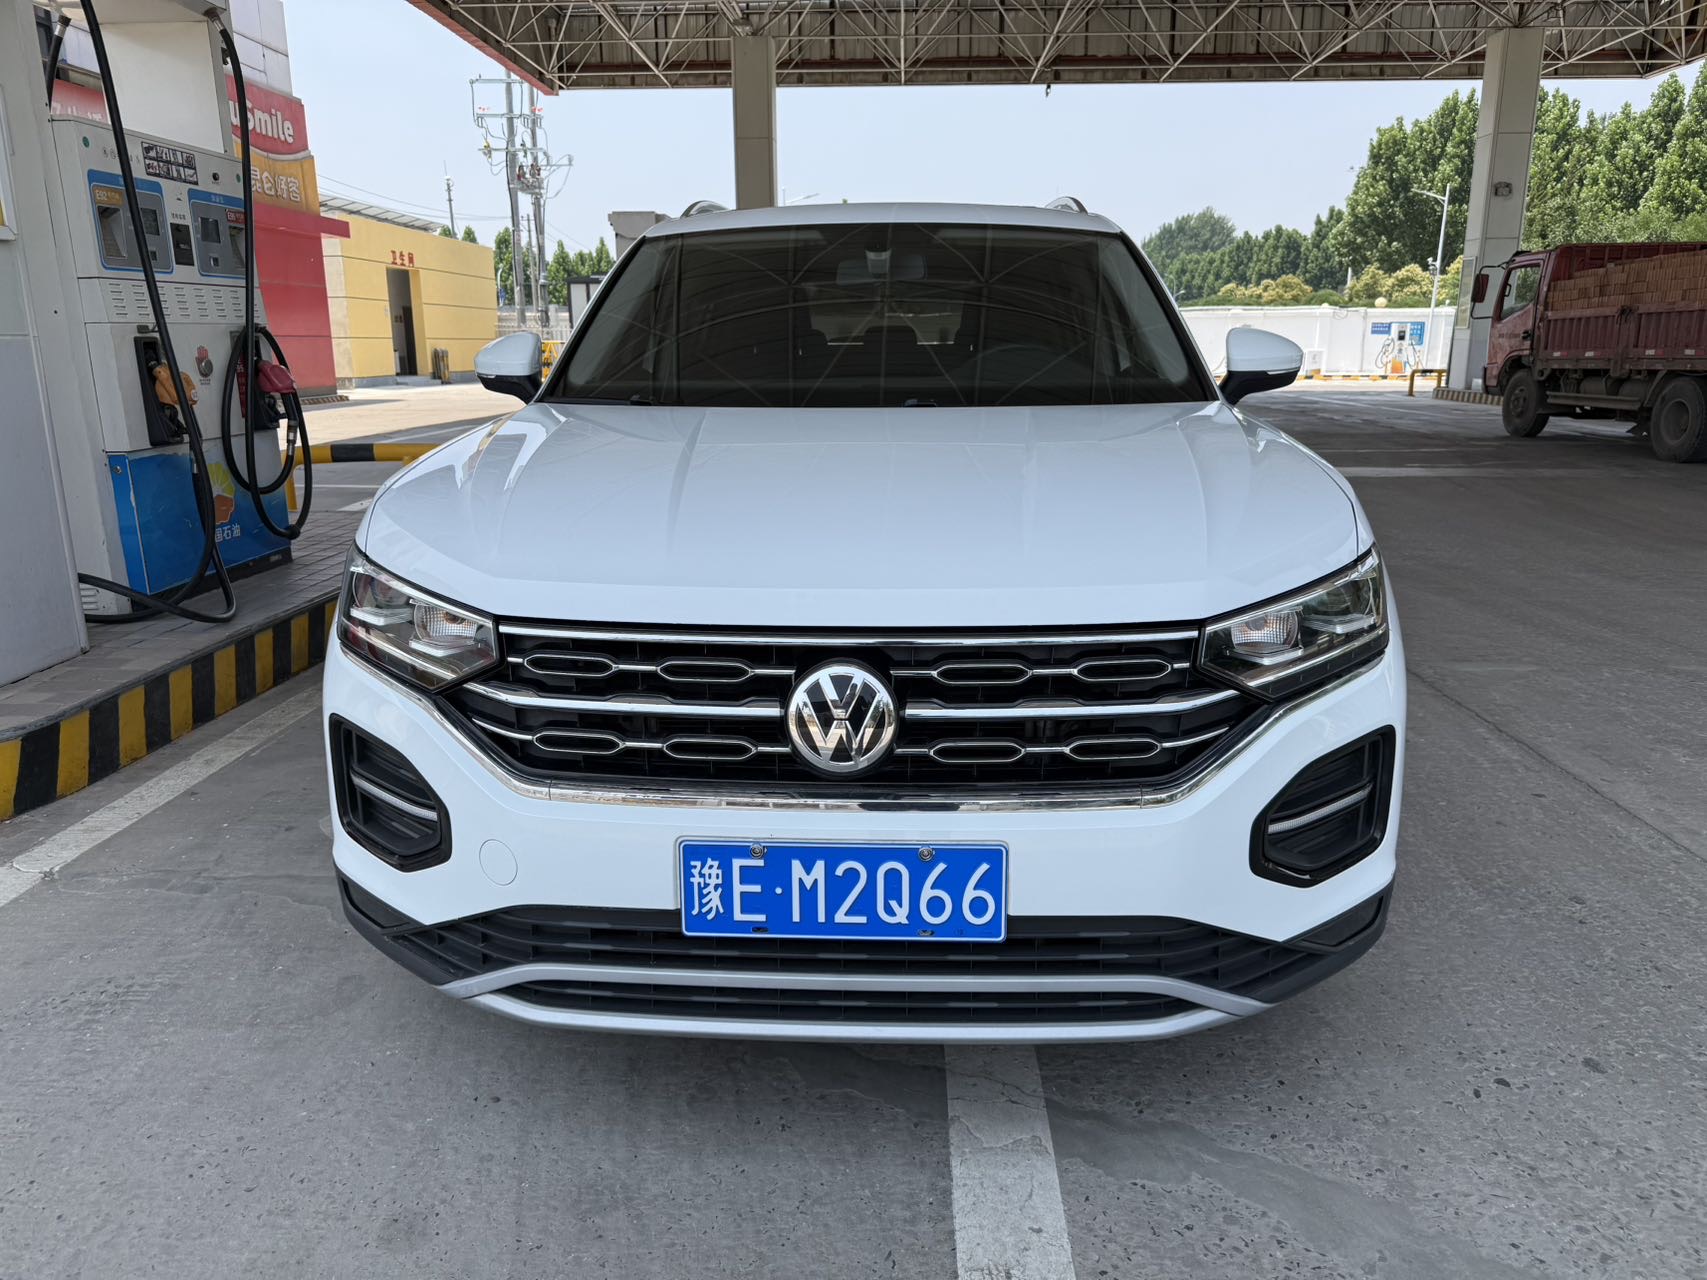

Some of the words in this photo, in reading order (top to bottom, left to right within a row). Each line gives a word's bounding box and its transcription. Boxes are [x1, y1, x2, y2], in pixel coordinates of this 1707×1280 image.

[250, 166, 300, 202] 昆仑好客
[215, 522, 241, 542] 国石油
[690, 857, 996, 926] 豫E·M2Q66
